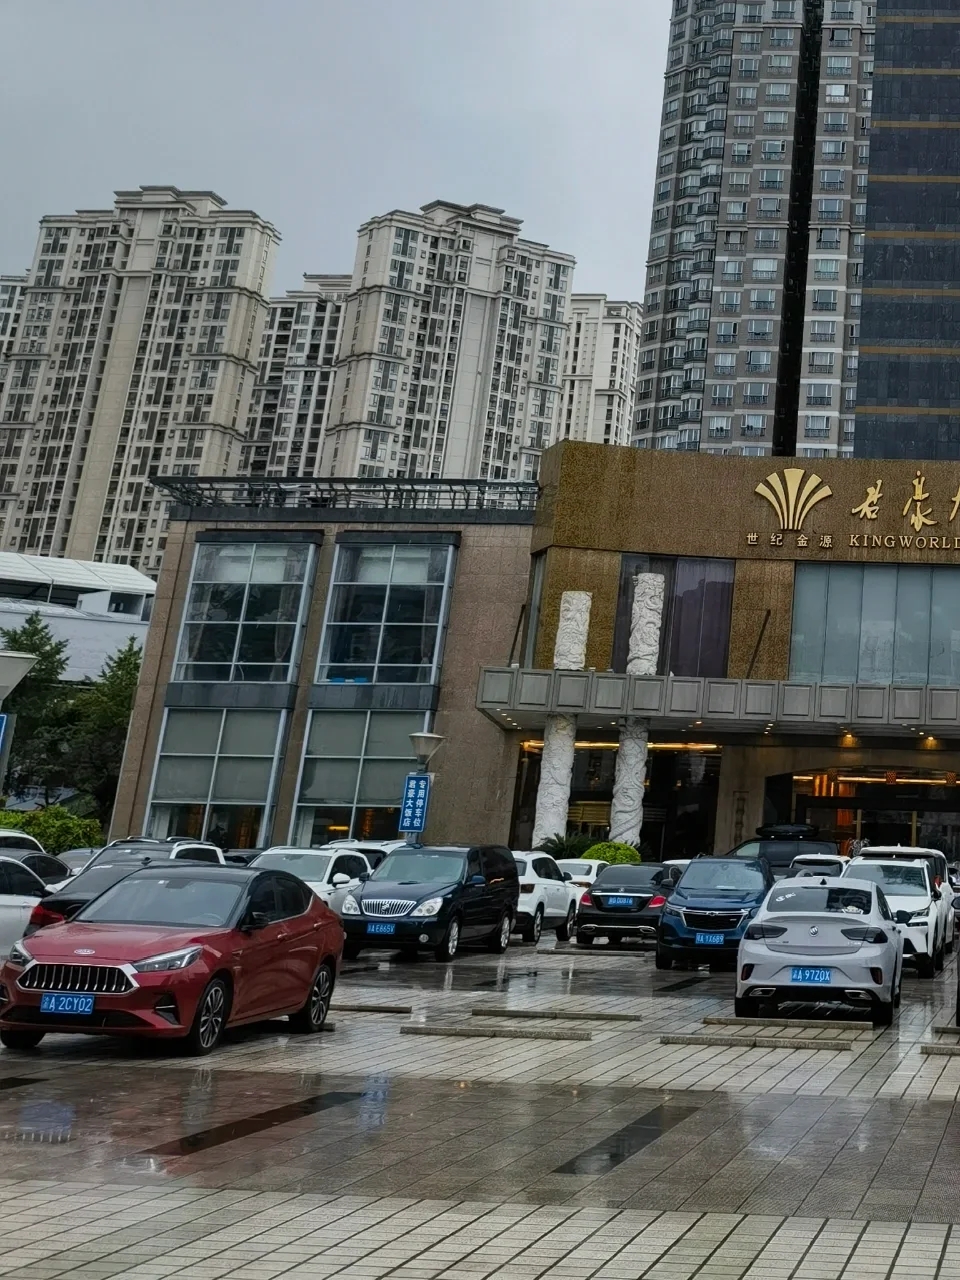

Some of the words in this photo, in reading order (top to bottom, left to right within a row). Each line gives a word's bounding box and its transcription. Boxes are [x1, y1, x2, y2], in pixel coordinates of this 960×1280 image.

[746, 532, 833, 548] 世纪金源
[403, 780, 416, 827] 君豪大饭店
[413, 780, 427, 827] 专用停车位
